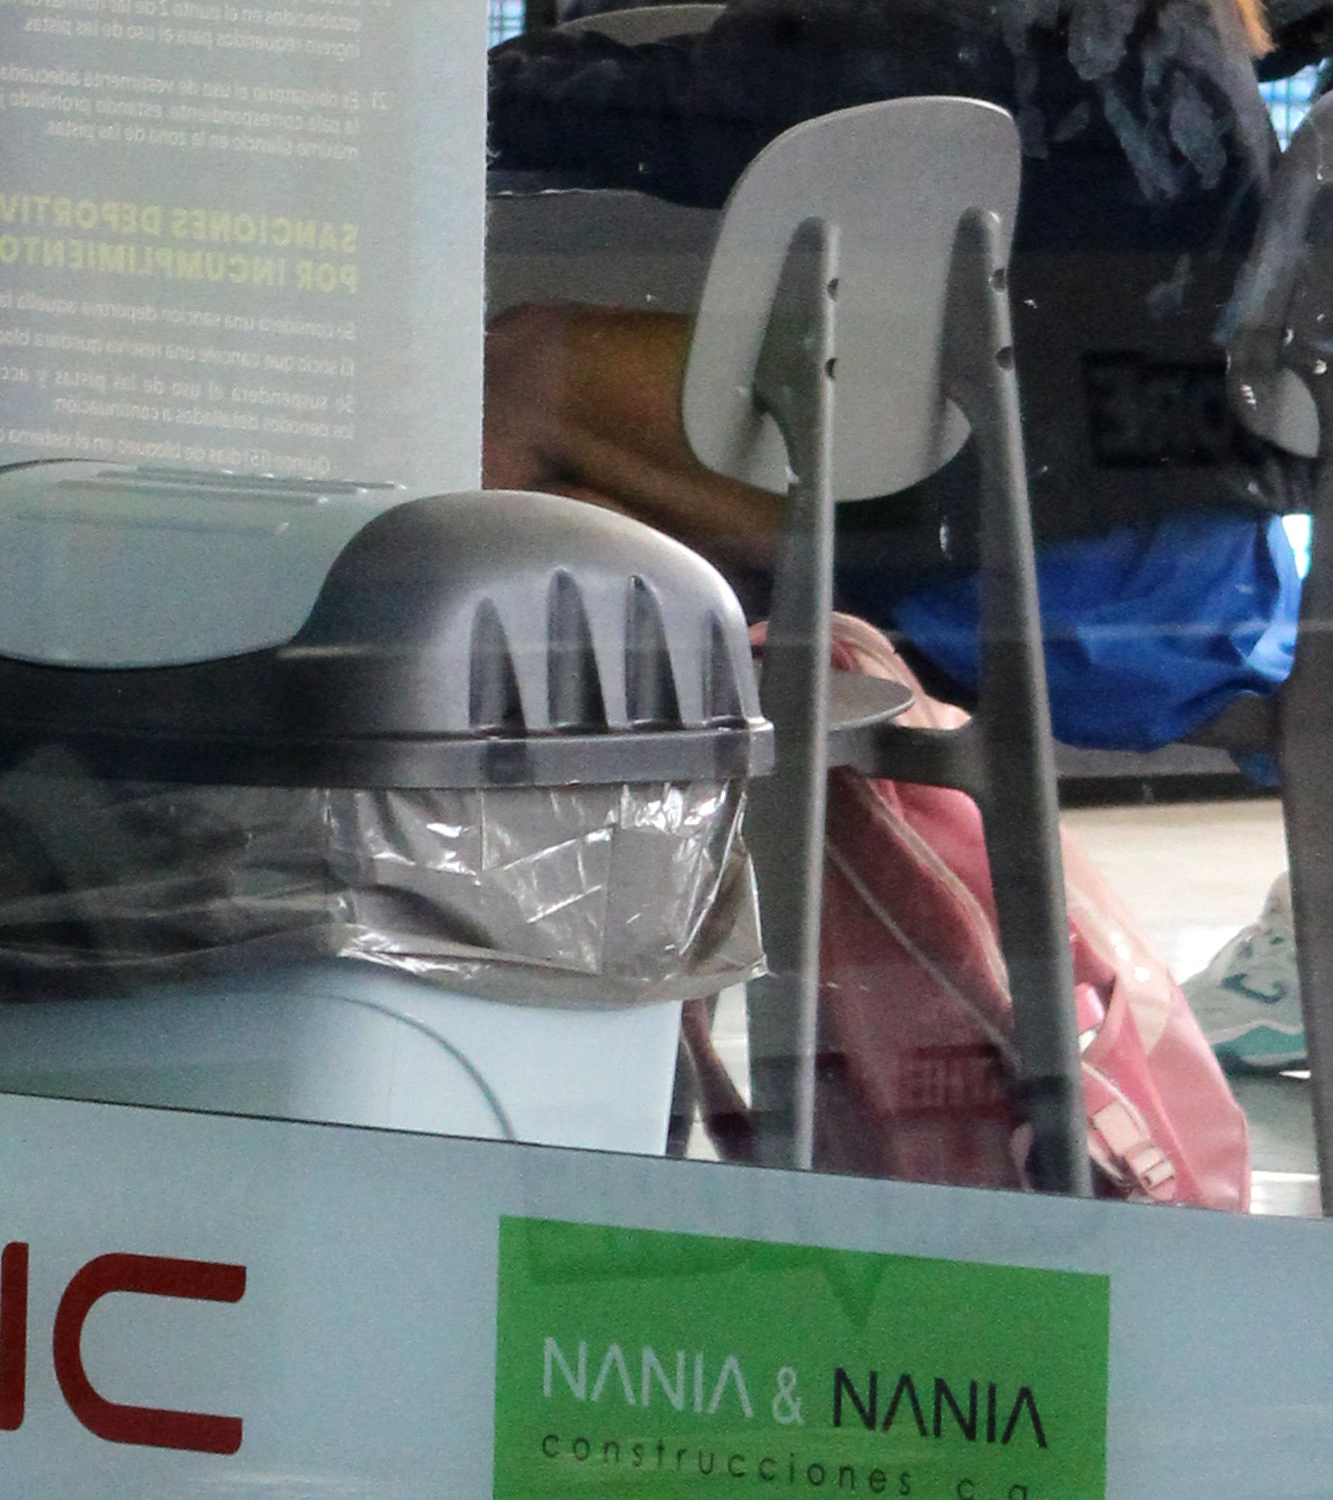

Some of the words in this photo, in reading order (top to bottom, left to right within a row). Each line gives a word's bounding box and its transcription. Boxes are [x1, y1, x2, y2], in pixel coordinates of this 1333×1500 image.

[542, 1336, 755, 1419] NANIA
[771, 1365, 805, 1426] &
[833, 1367, 1048, 1449] NANIA
[541, 1432, 913, 1497] construcciones
